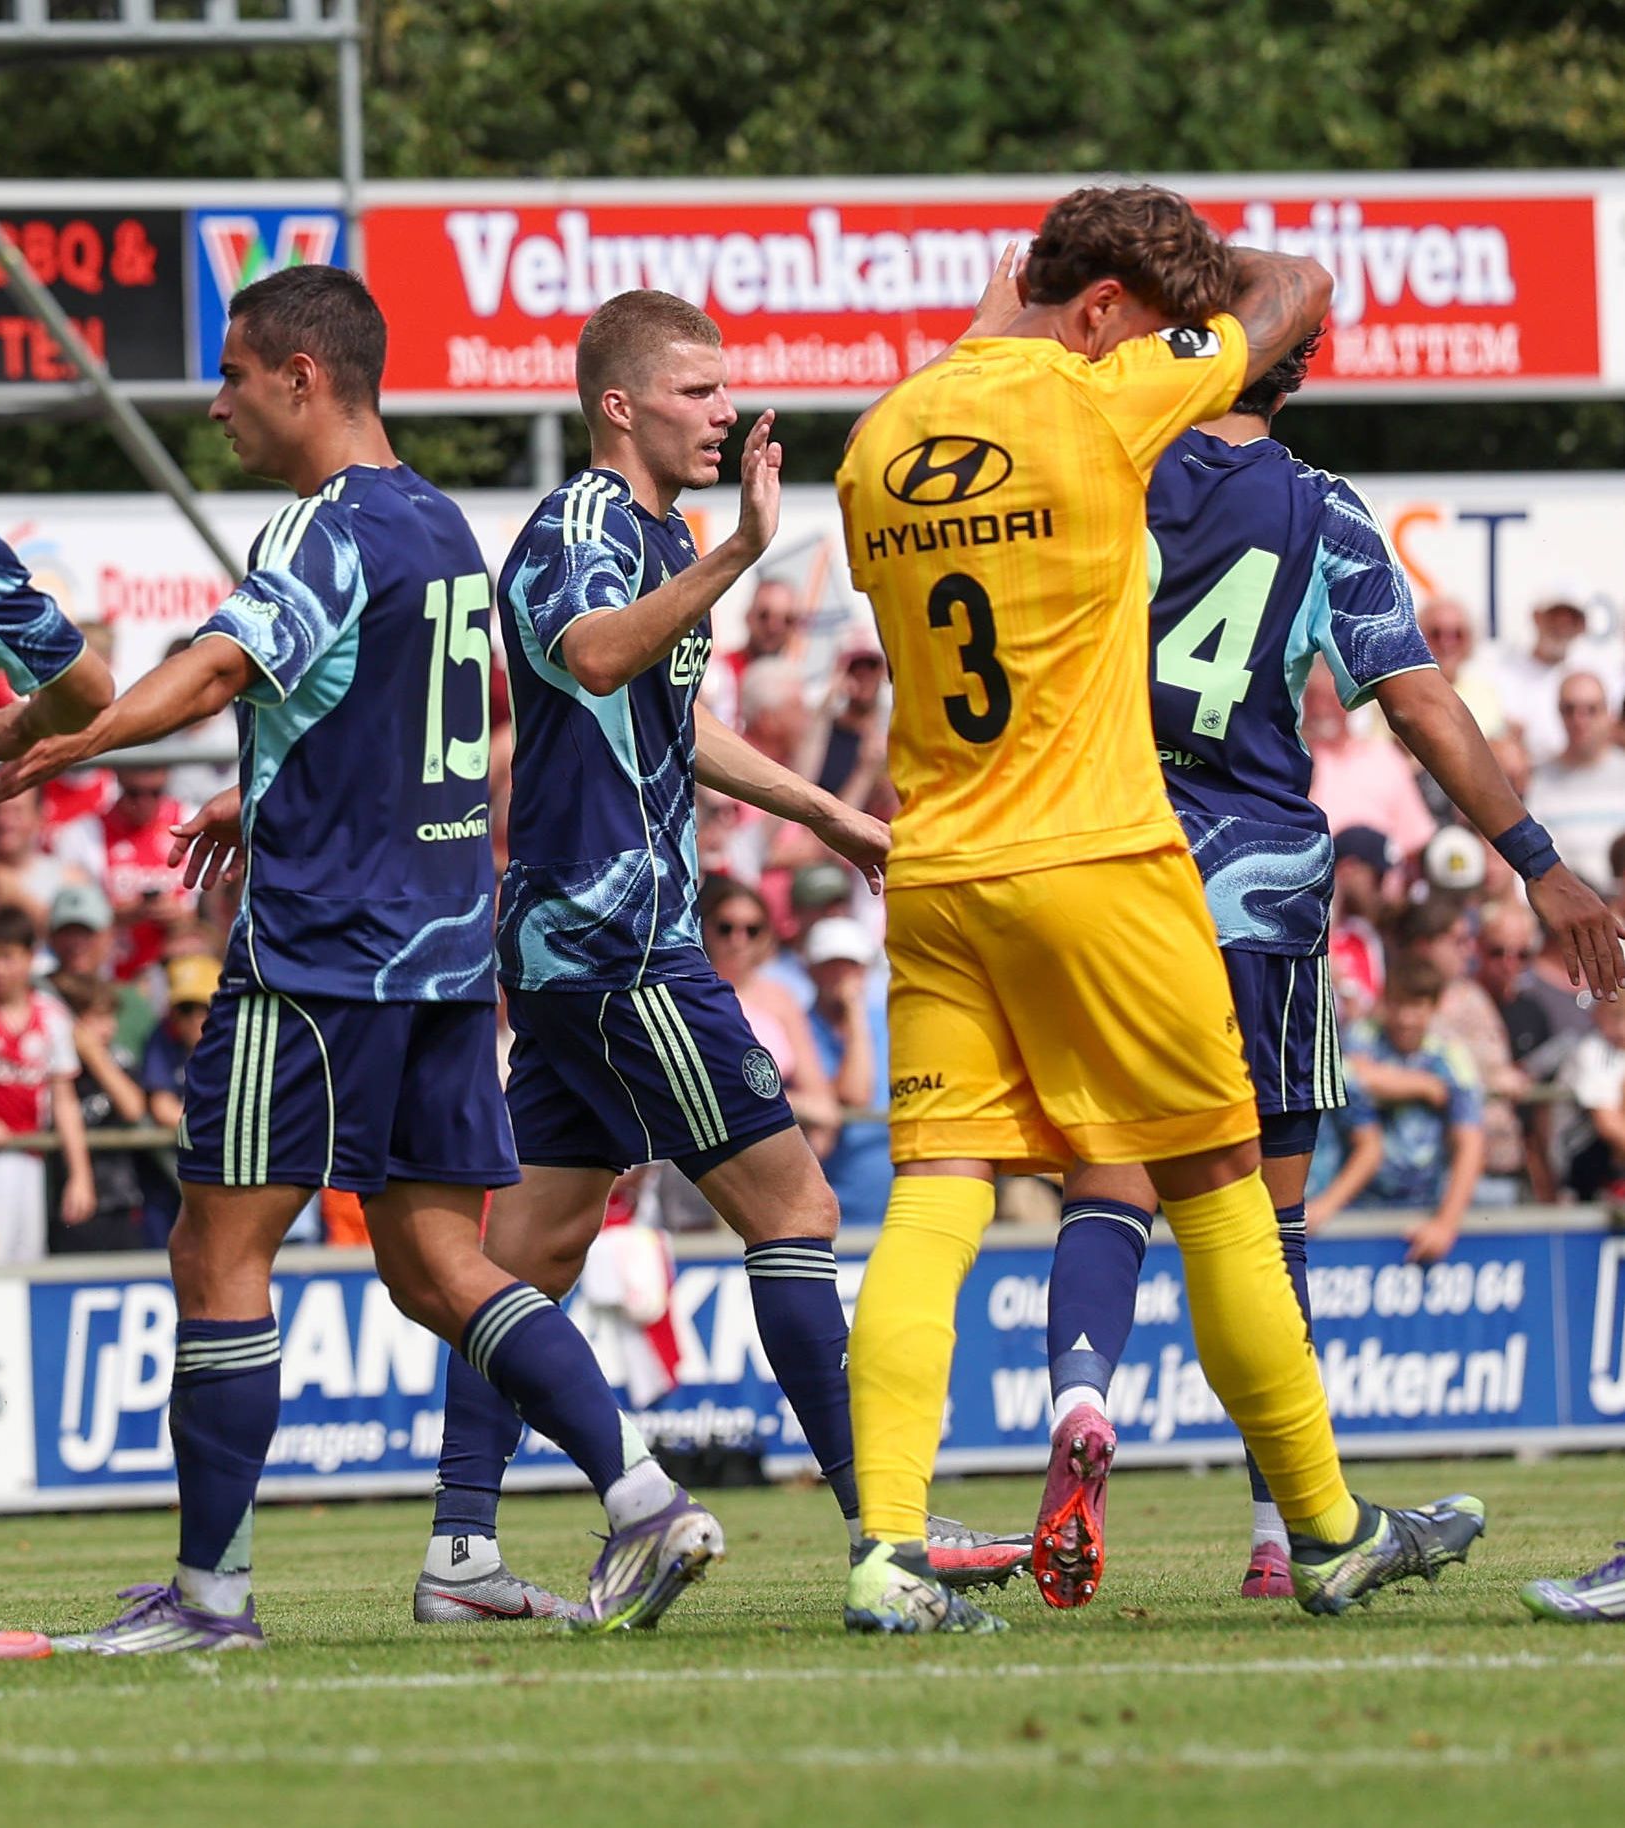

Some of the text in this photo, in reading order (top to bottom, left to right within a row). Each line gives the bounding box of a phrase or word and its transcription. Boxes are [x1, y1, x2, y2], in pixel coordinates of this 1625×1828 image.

[110, 218, 158, 286] &
[445, 206, 1031, 318] Veluwenkam
[1331, 323, 1521, 376] HATTEM
[865, 508, 1053, 561] HYUNDAI
[422, 572, 492, 784] 15
[927, 572, 1013, 744] 3
[269, 1277, 439, 1401] AN
